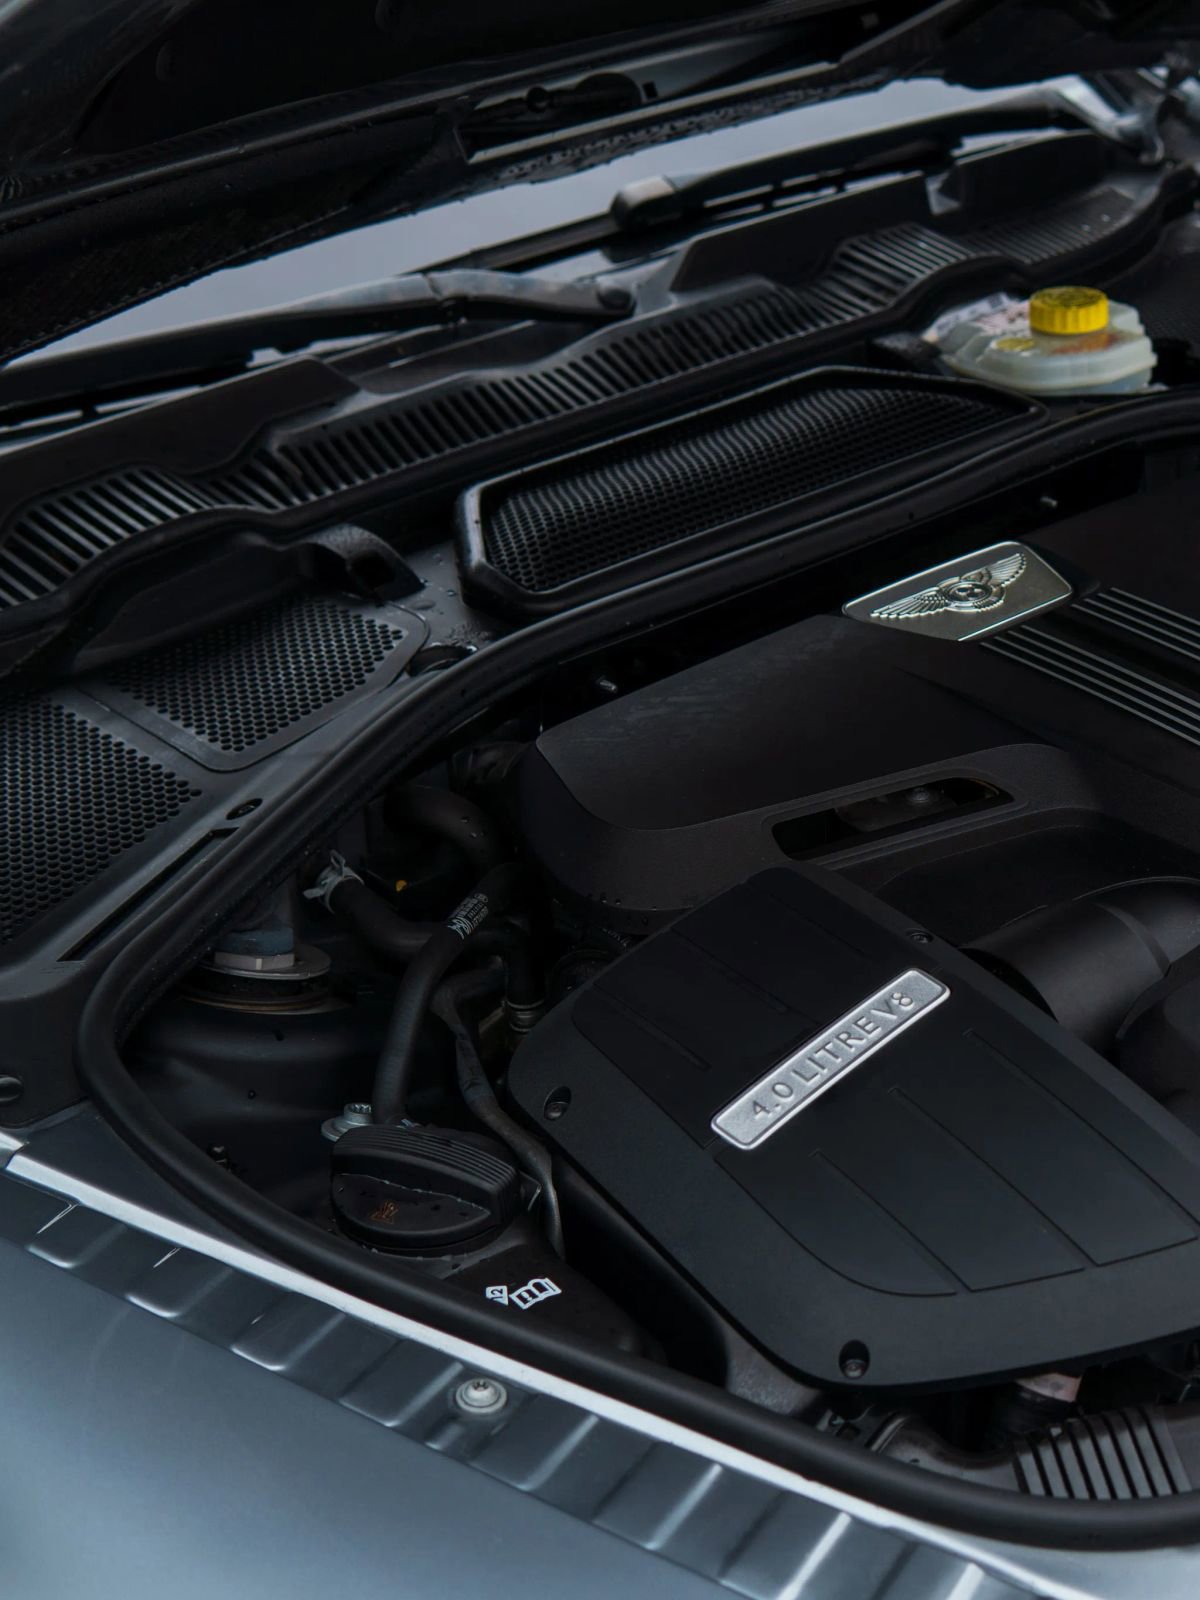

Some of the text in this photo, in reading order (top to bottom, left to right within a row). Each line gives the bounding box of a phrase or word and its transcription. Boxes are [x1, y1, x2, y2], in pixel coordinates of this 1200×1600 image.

[751, 991, 914, 1119] 4.0 LITRE V8
